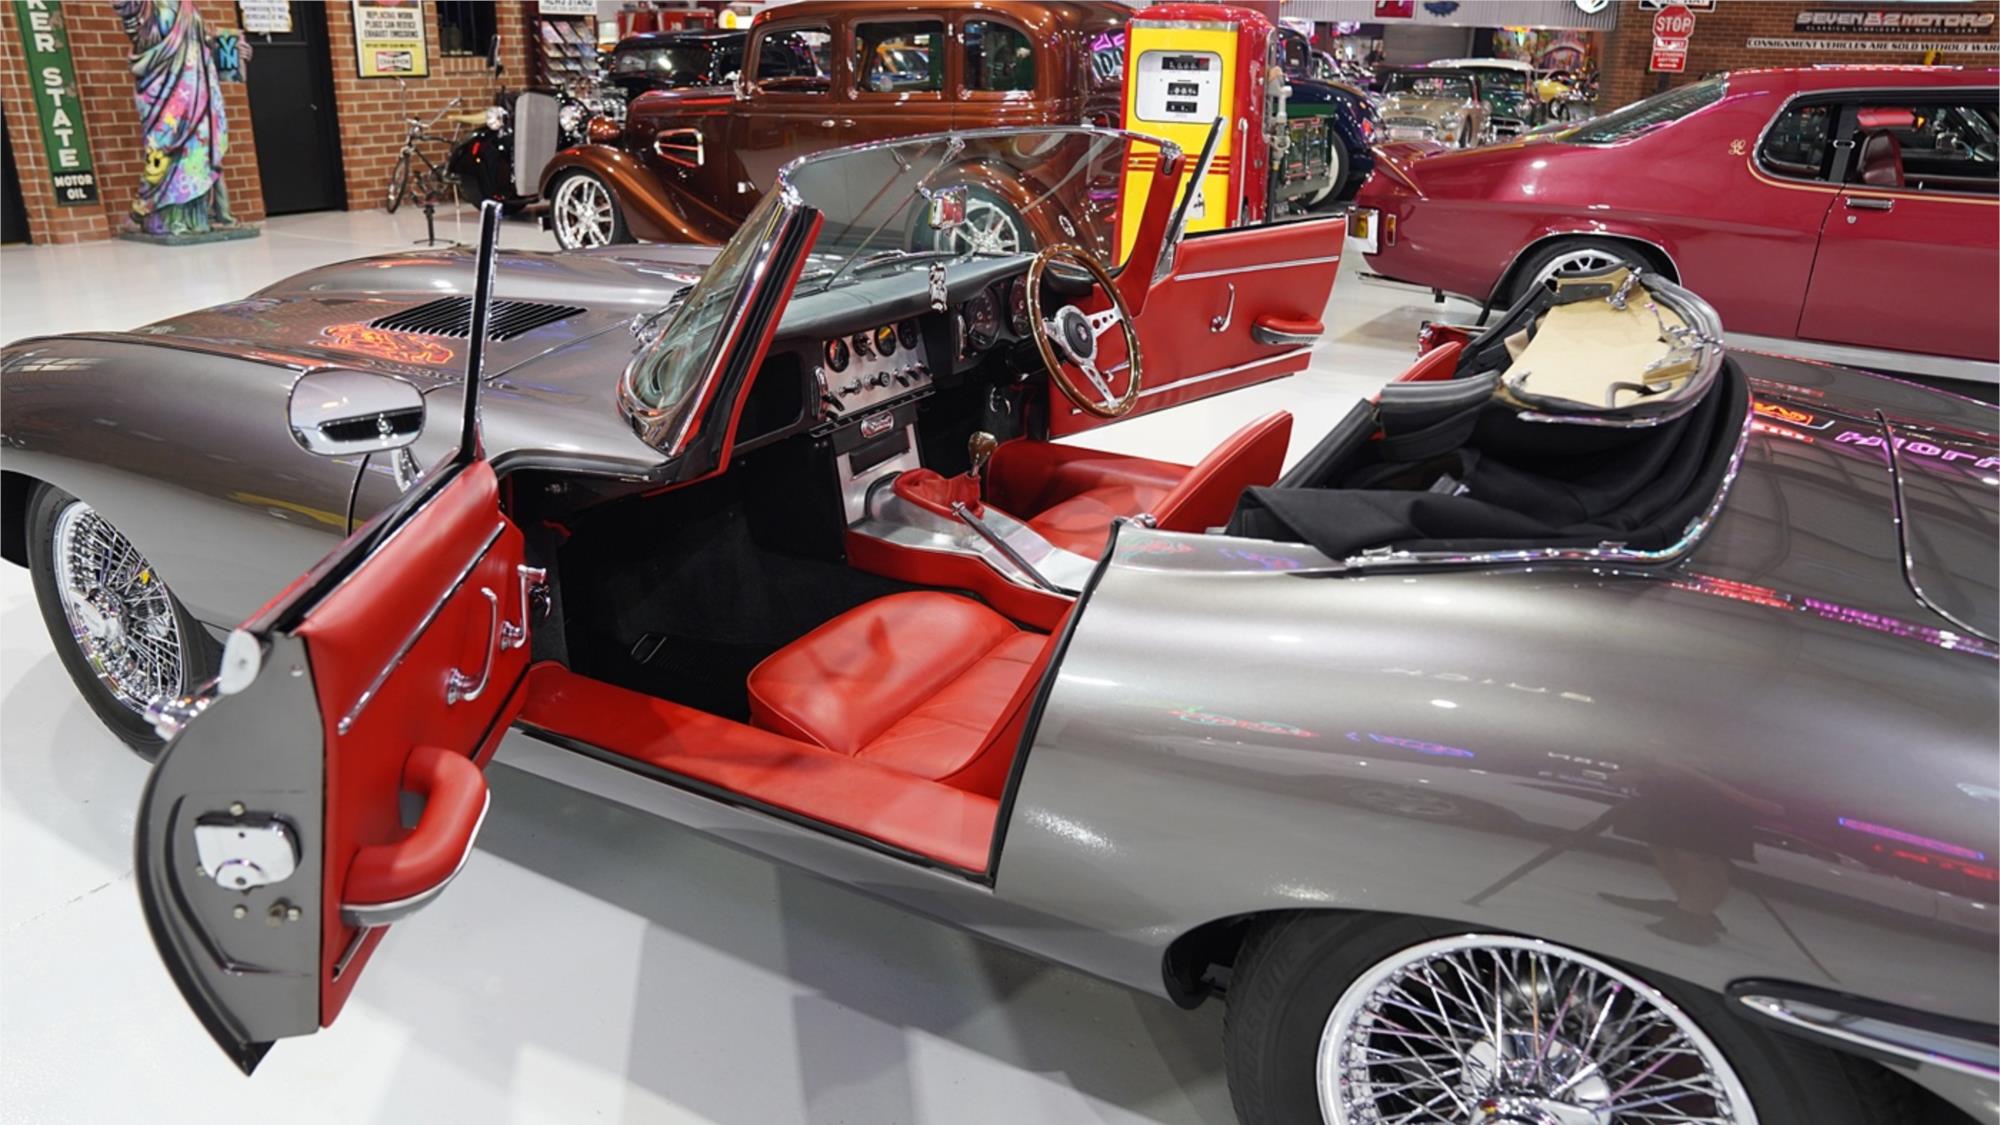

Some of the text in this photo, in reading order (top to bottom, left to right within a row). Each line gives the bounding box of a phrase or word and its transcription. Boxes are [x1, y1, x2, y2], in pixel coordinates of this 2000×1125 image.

[1656, 16, 1692, 33] STOP
[1796, 12, 1864, 25] SEVEN
[1901, 13, 1995, 27] MOTORS
[1748, 39, 1817, 48] CONSIGNMENT
[1818, 40, 1867, 49] VEHICLES
[1869, 41, 1889, 49] ARE
[1891, 42, 1919, 50] SOLD
[1921, 42, 1969, 51] WITHOUT
[42, 67, 80, 167] STATE
[54, 175, 93, 187] MOTOR
[67, 188, 87, 200] OIL
